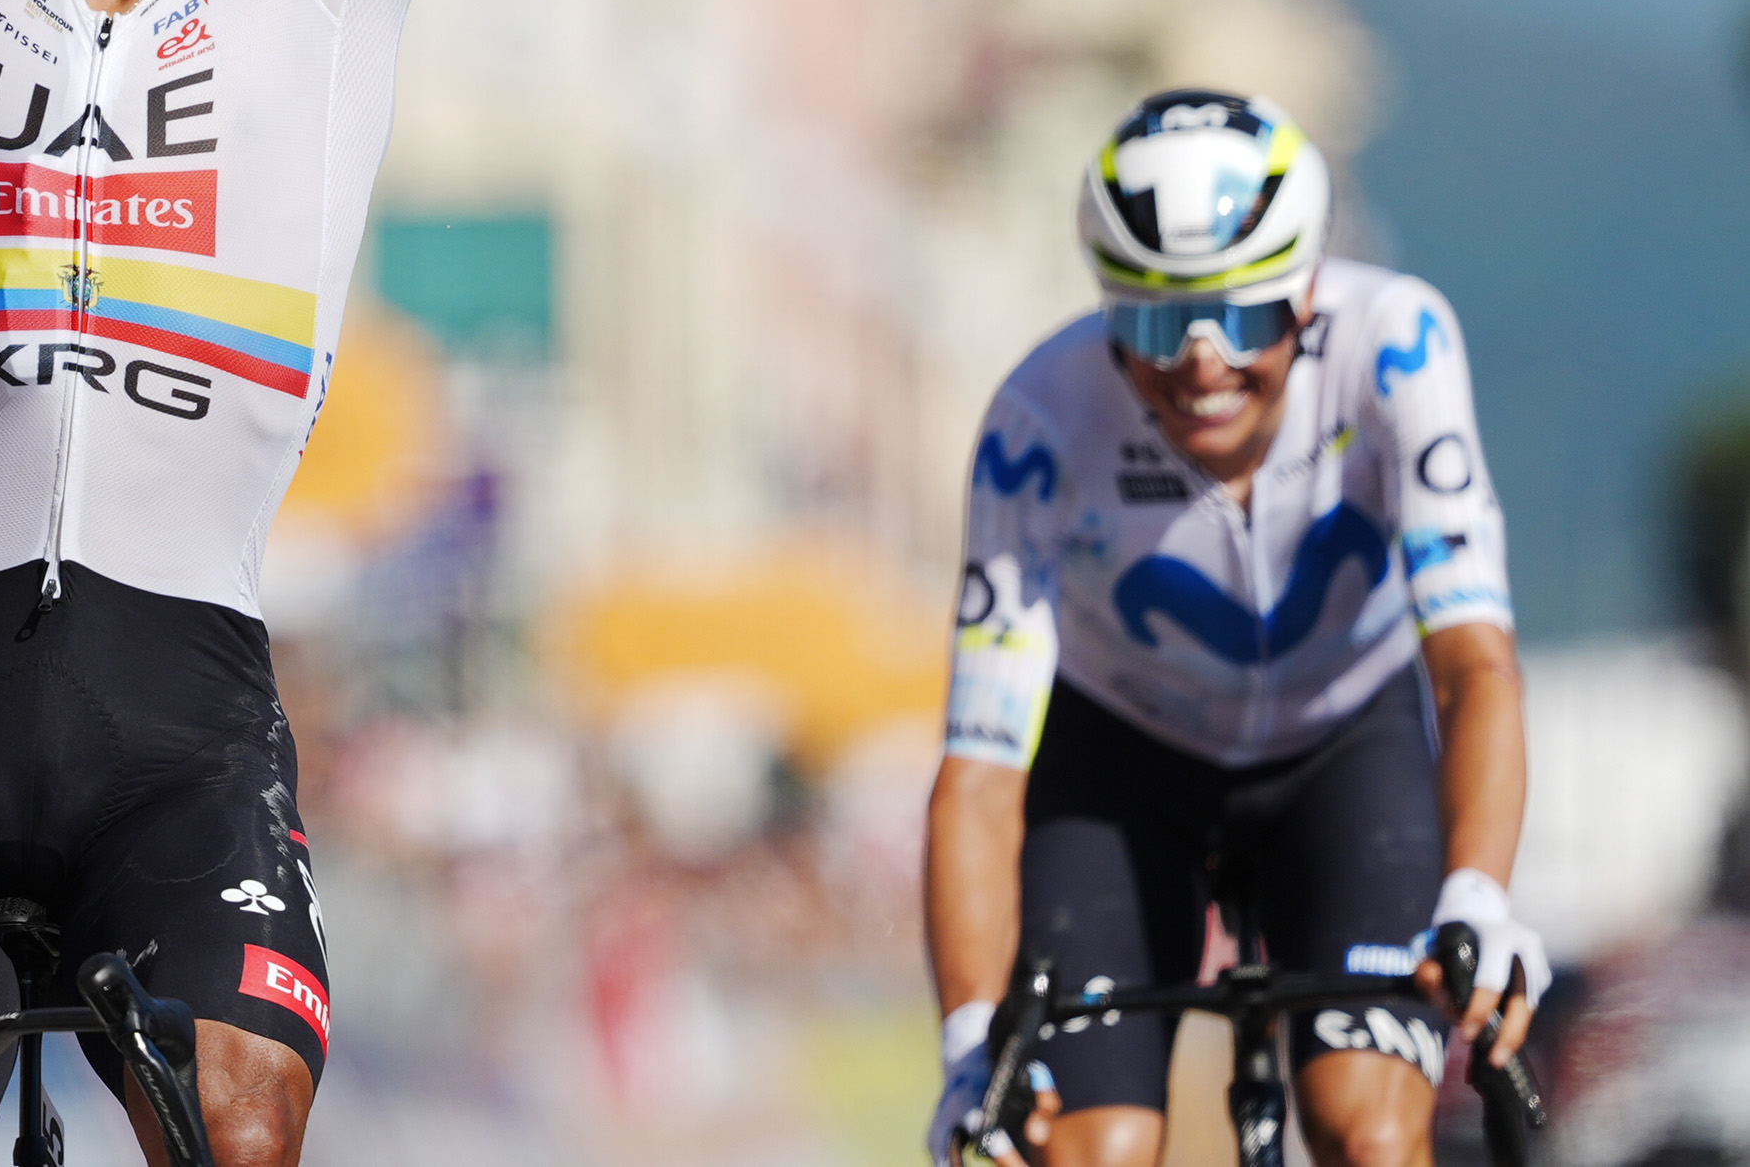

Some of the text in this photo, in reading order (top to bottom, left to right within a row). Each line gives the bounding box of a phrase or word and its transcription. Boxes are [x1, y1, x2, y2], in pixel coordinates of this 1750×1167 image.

[4, 22, 58, 64] PISSEI
[158, 42, 216, 71] etisalat and
